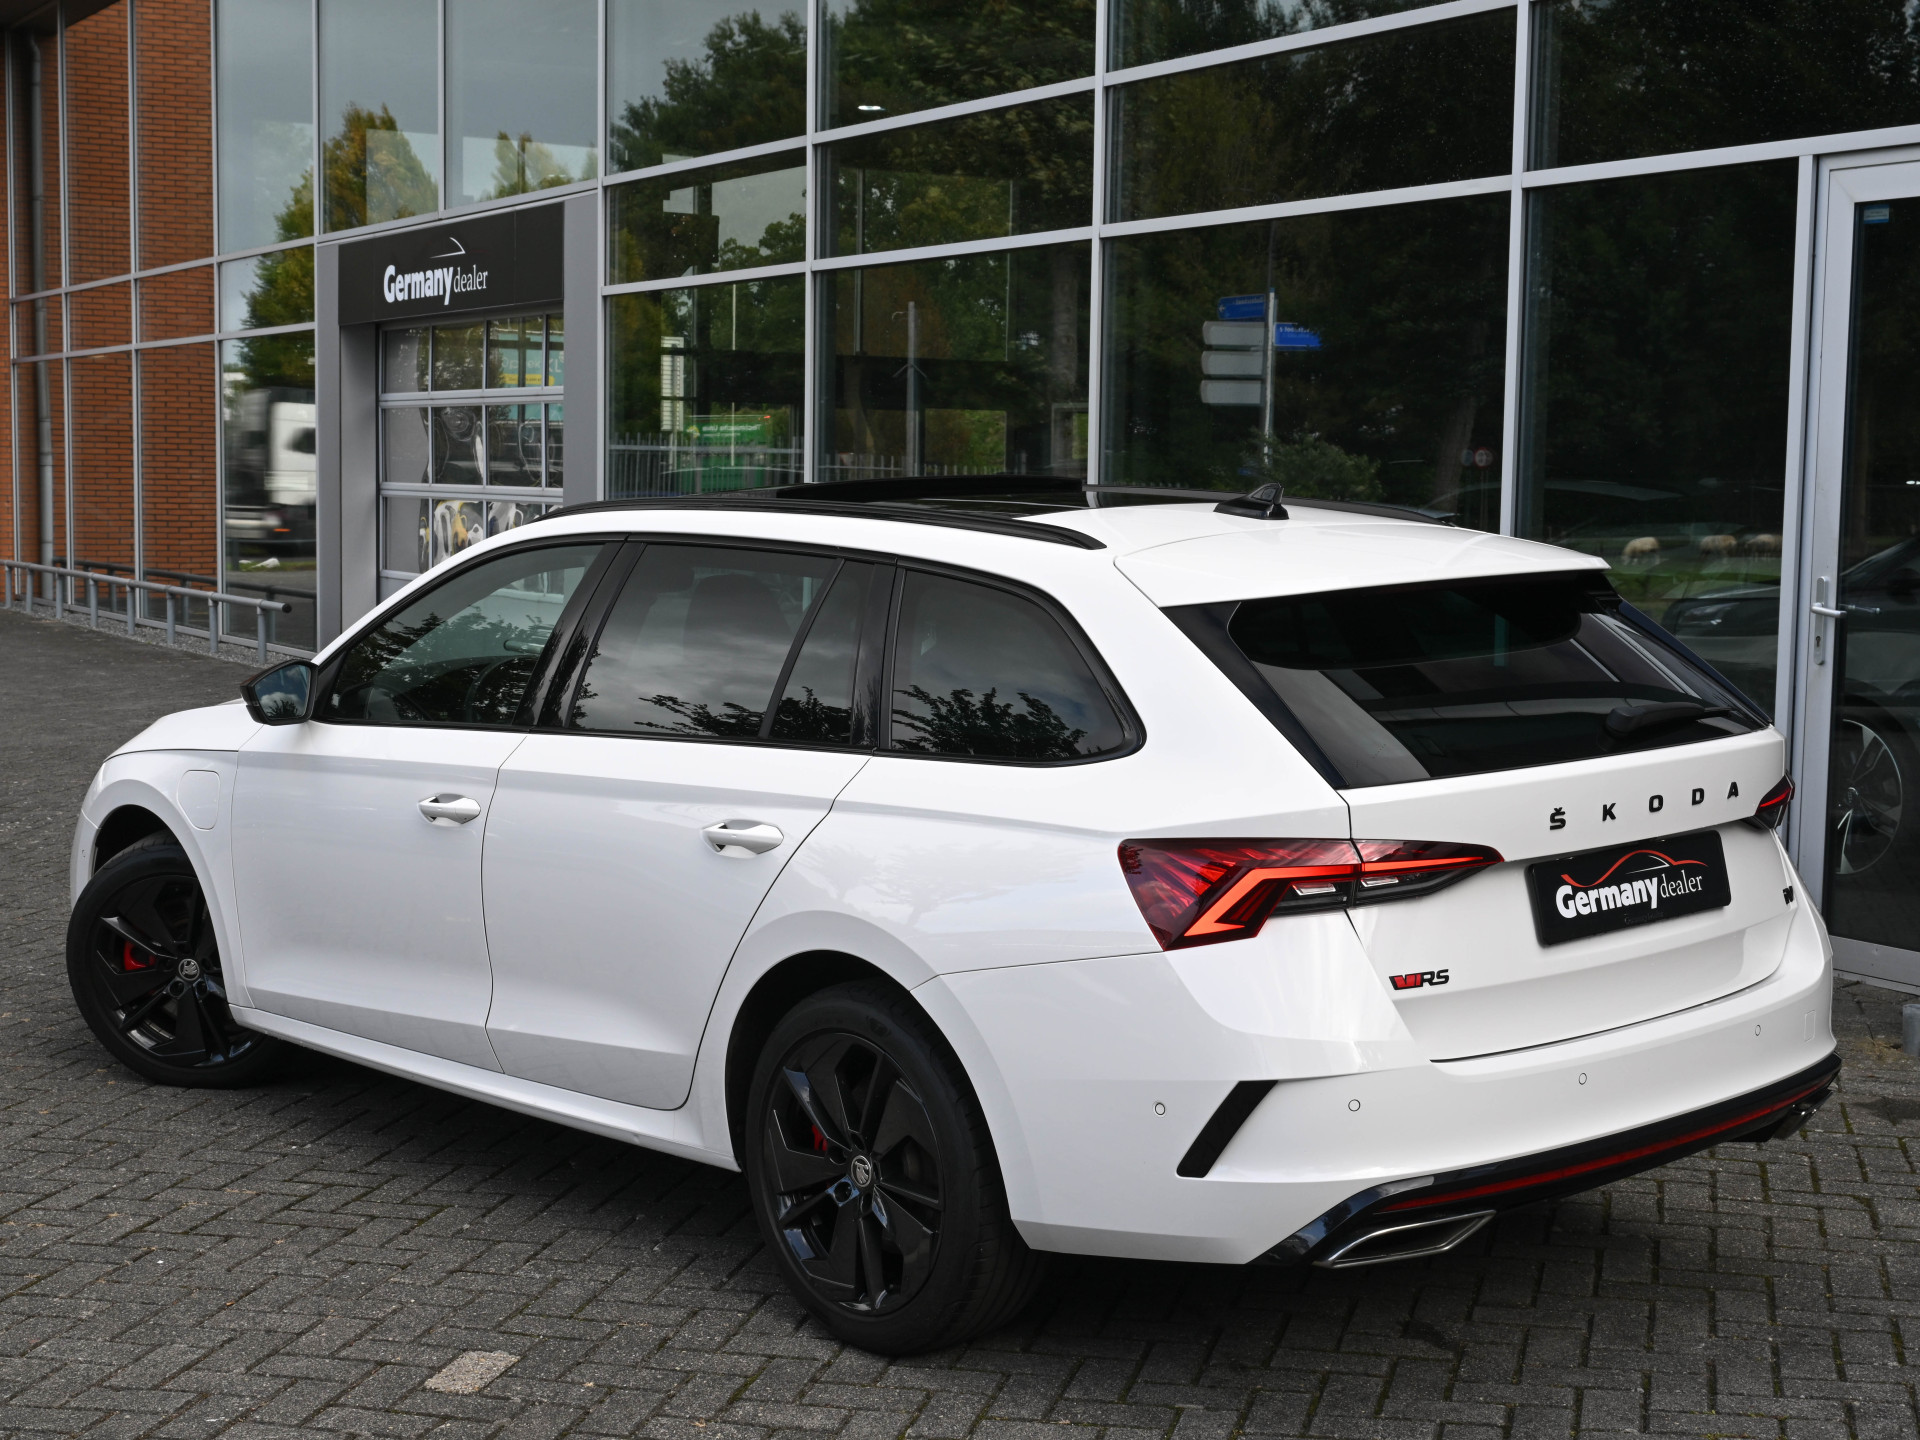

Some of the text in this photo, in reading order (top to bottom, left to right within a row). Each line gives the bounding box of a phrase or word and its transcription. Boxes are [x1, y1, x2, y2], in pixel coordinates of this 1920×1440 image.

[383, 264, 488, 306] Germany dealer
[1549, 781, 1739, 831] ŠKODA
[1555, 870, 1703, 918] Germany dealer
